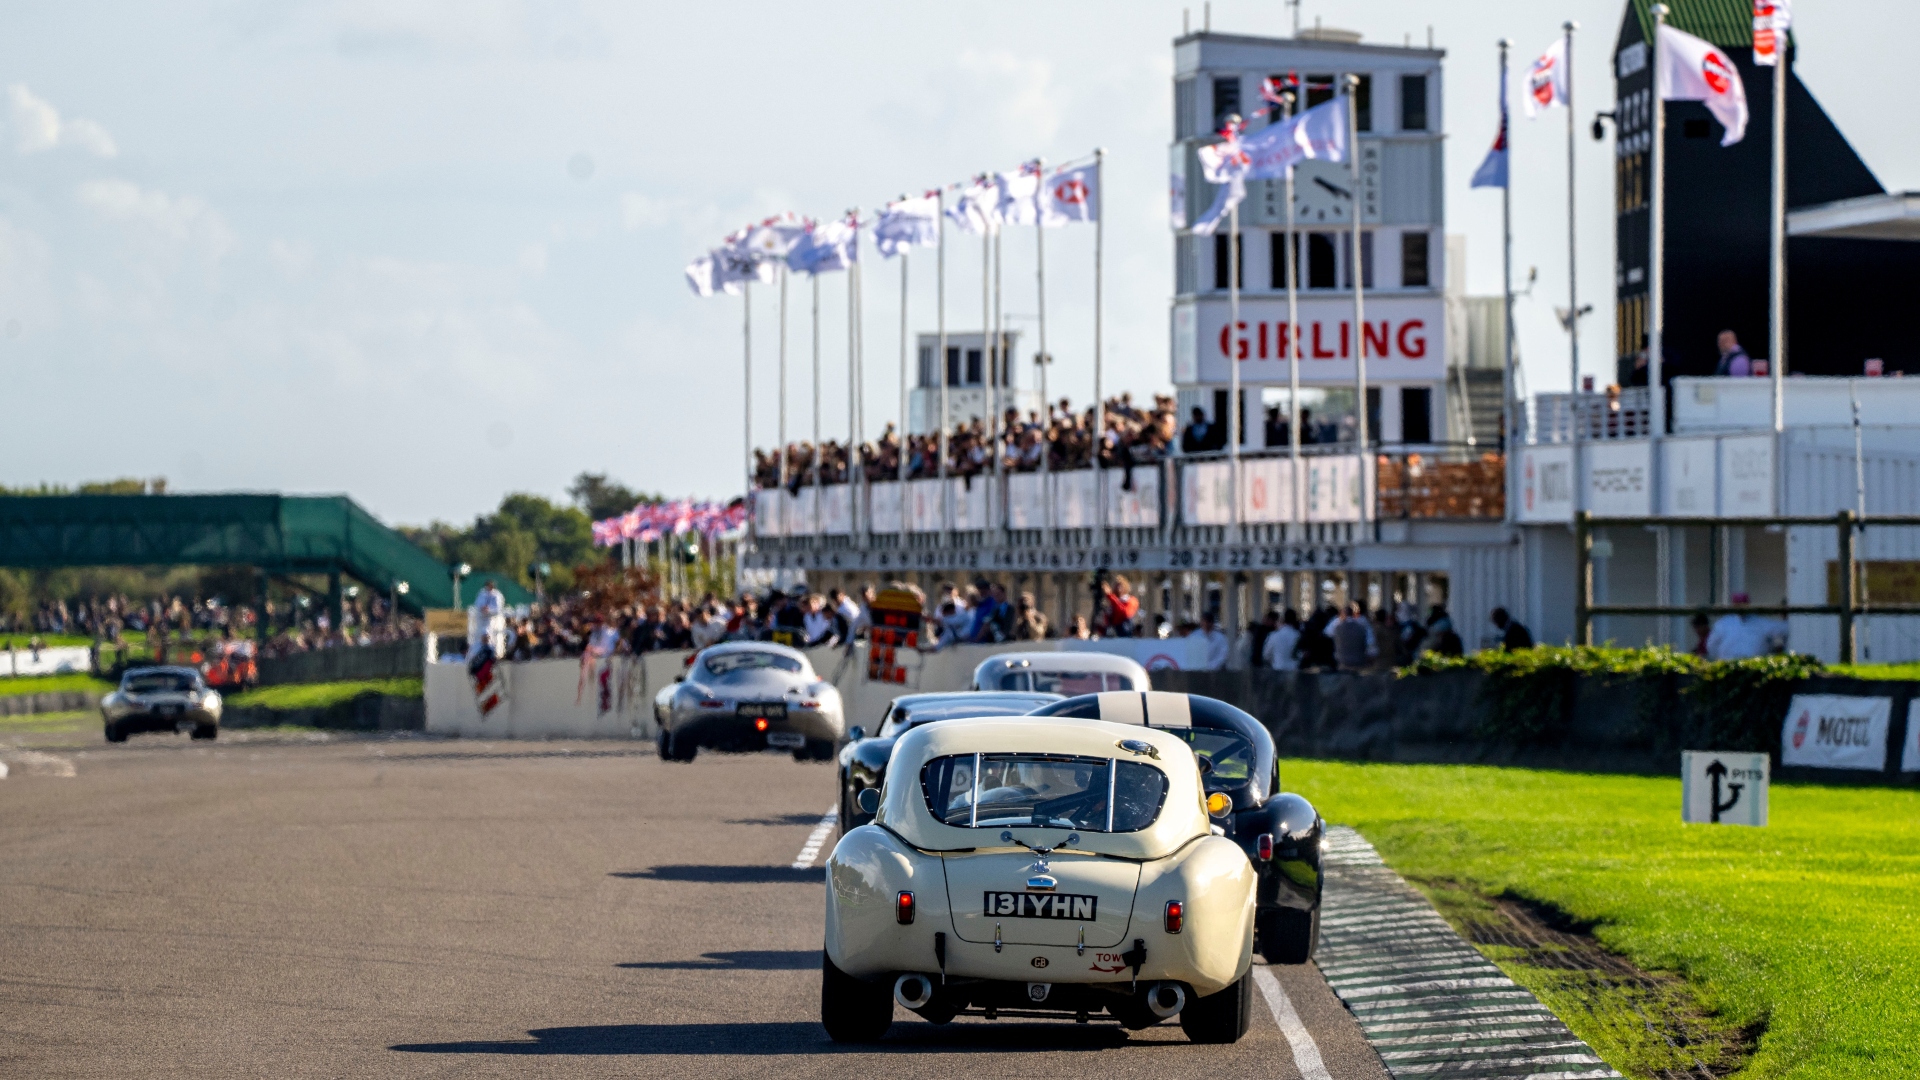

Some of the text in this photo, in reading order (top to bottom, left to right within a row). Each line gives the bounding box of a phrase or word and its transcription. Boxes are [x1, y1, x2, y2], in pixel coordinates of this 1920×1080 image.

[1218, 319, 1427, 360] GIRLING
[859, 551, 868, 567] 7
[916, 550, 935, 567] 10
[1017, 550, 1037, 567] 15
[1066, 550, 1085, 566] 17
[1117, 548, 1139, 565] 19
[1169, 549, 1193, 566] 20
[1199, 549, 1219, 566] 21
[1229, 549, 1251, 566] 22
[1292, 547, 1317, 566] 24
[1325, 547, 1350, 565] 25
[1816, 716, 1871, 747] MOTUL
[1731, 768, 1763, 781] PITS
[987, 893, 1094, 919] 131YHN
[1033, 957, 1047, 968] GB
[1095, 953, 1122, 963] TOW
